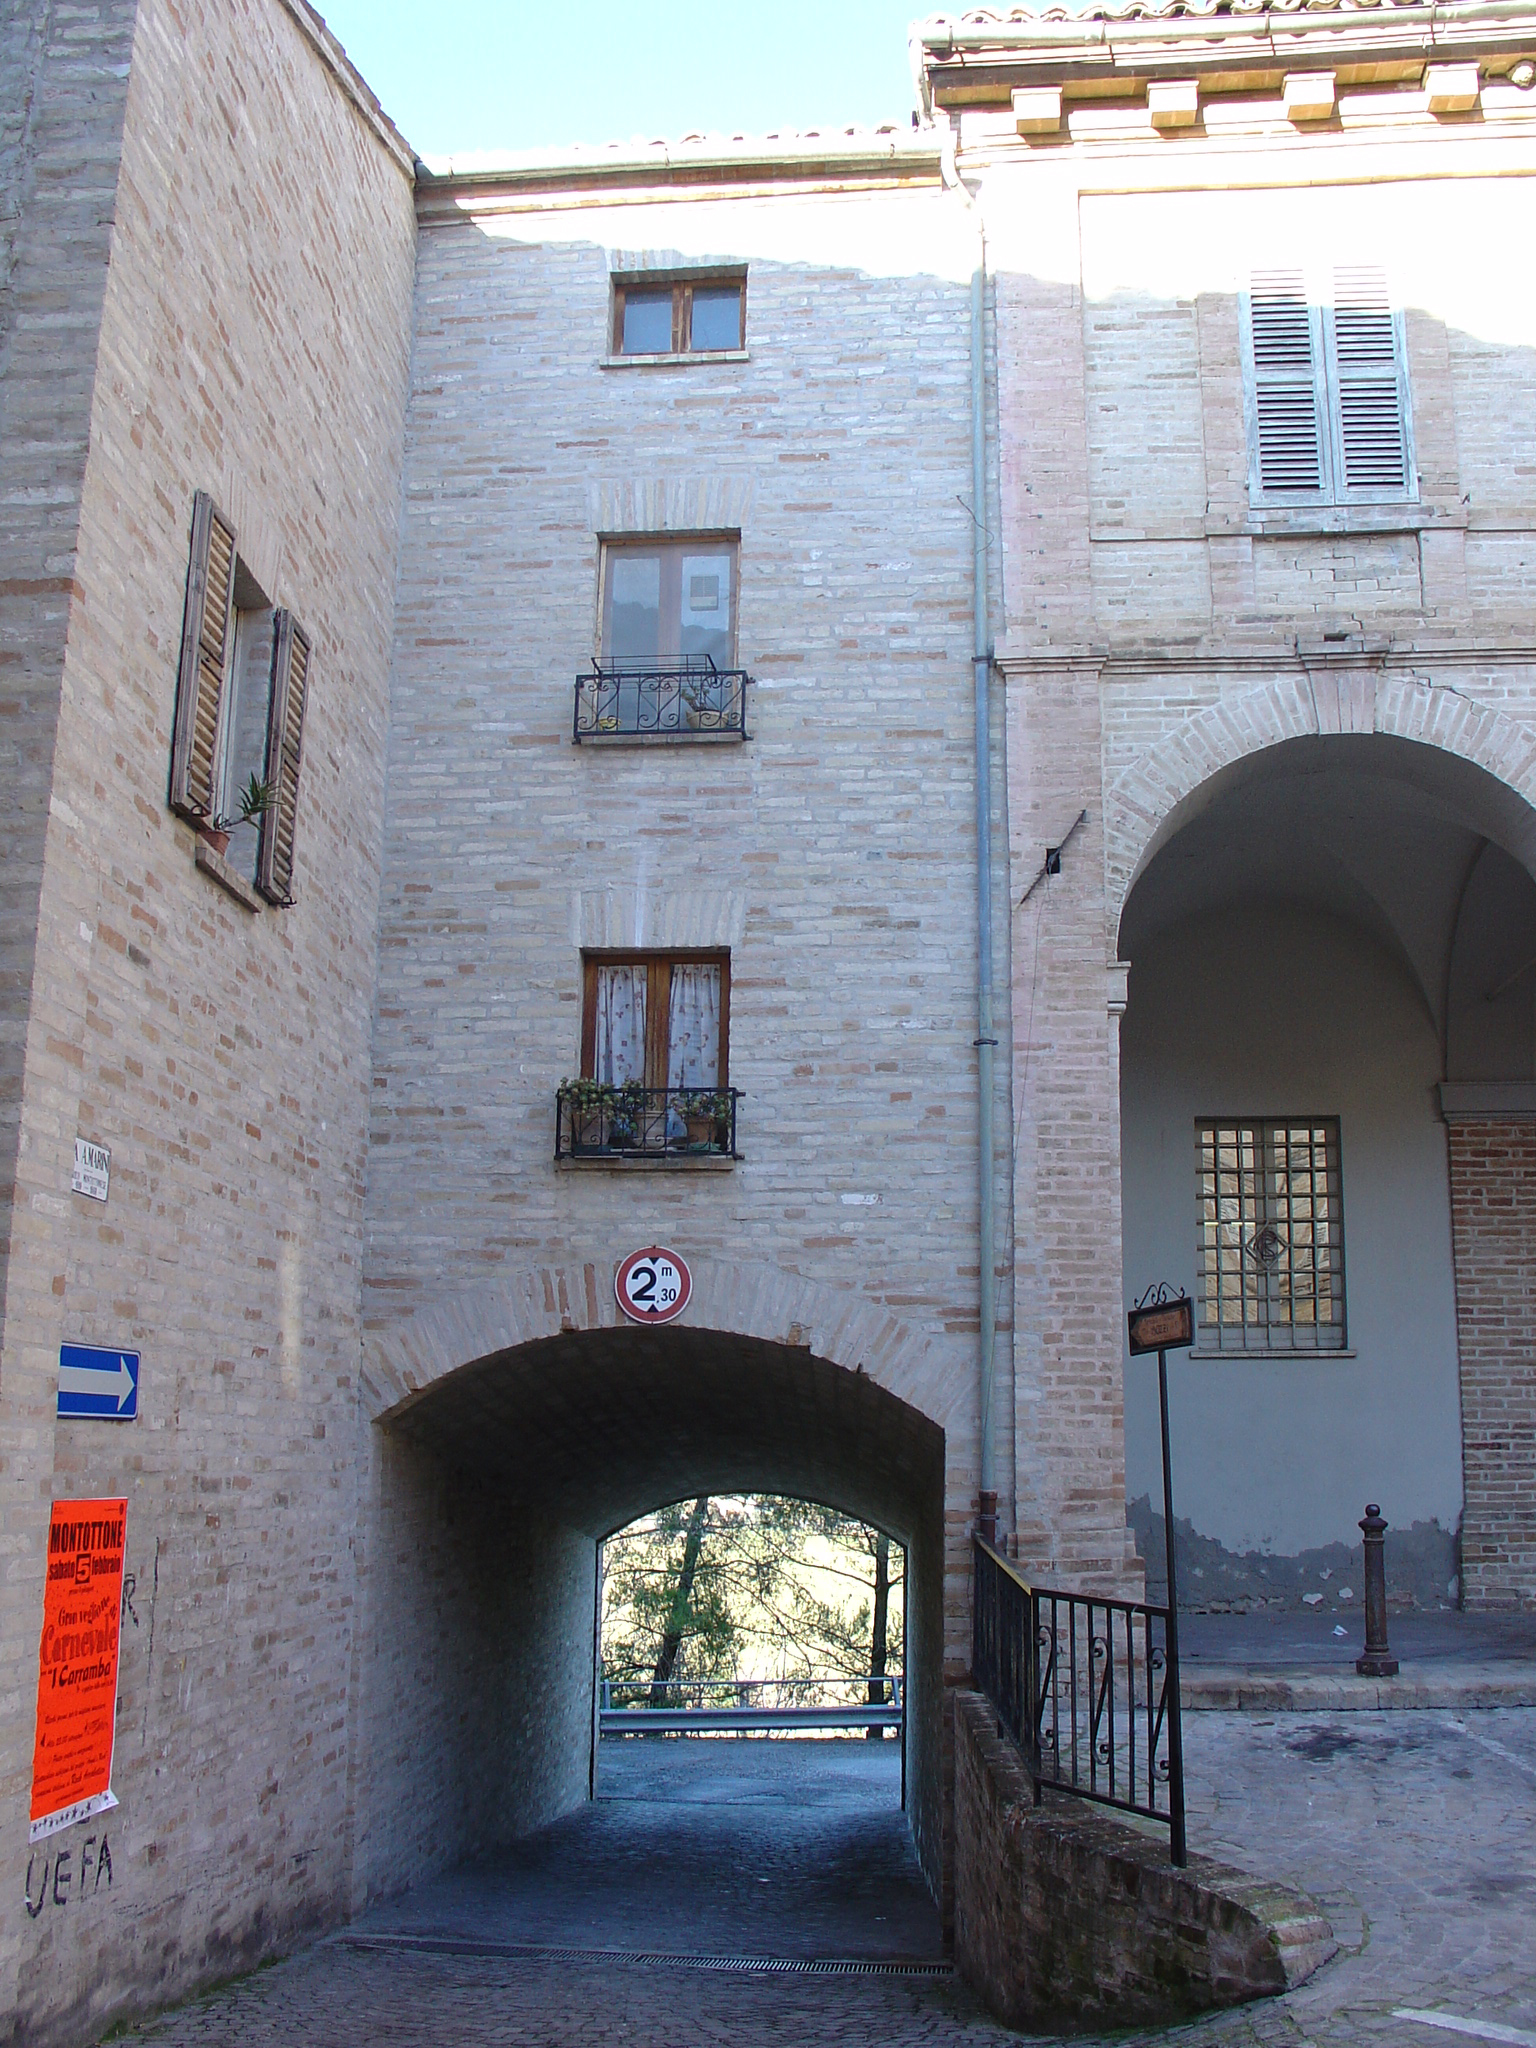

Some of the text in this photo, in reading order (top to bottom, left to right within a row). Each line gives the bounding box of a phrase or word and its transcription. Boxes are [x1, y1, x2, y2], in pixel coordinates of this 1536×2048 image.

[50, 1520, 123, 1553] MONTOTTONE
[49, 1554, 120, 1583] sabato 5 febbraio
[42, 1612, 117, 1666] Carnevale
[25, 1833, 113, 1919] UEFA
